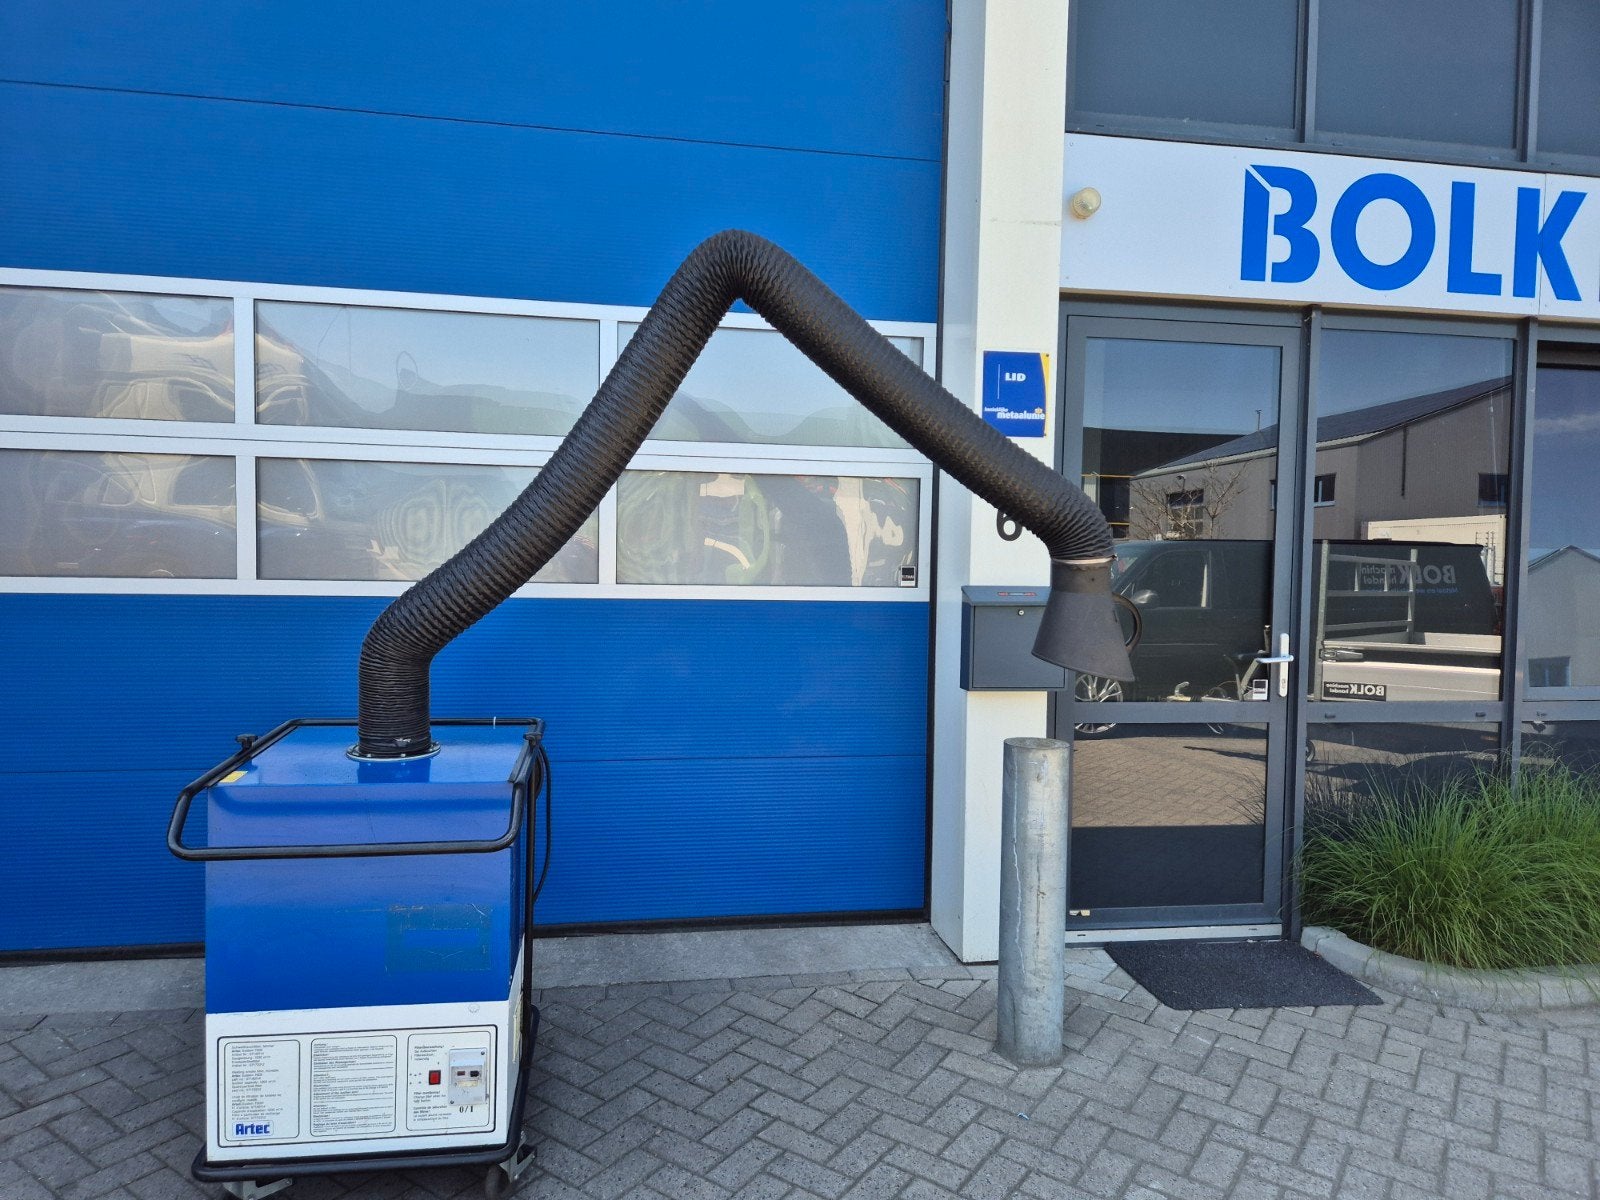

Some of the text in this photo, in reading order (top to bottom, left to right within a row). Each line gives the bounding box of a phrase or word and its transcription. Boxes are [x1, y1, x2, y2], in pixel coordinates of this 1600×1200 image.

[1240, 164, 1588, 301] BOLK
[1004, 372, 1027, 382] LID
[235, 1123, 270, 1136] Artec
